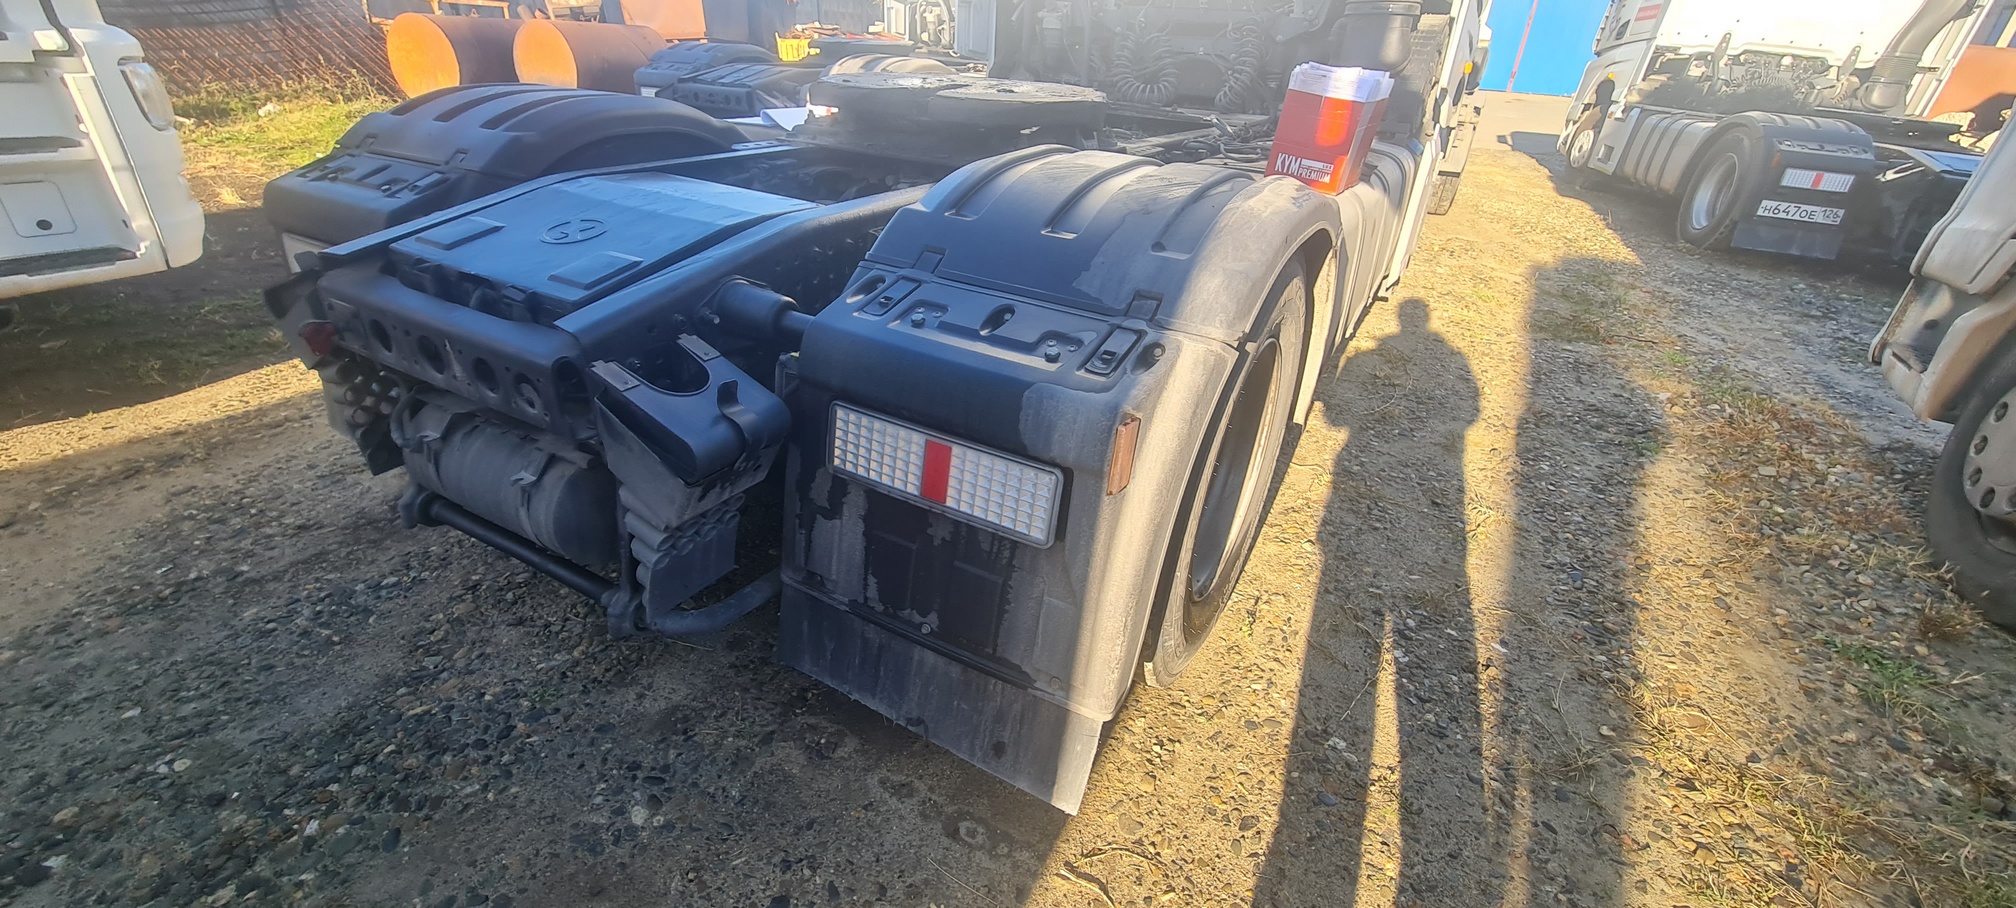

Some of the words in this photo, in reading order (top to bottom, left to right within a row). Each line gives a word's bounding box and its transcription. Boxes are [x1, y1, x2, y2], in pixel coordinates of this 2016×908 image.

[1275, 153, 1301, 176] KYM
[1297, 168, 1331, 184] PREMIUM
[1821, 209, 1839, 219] 126
